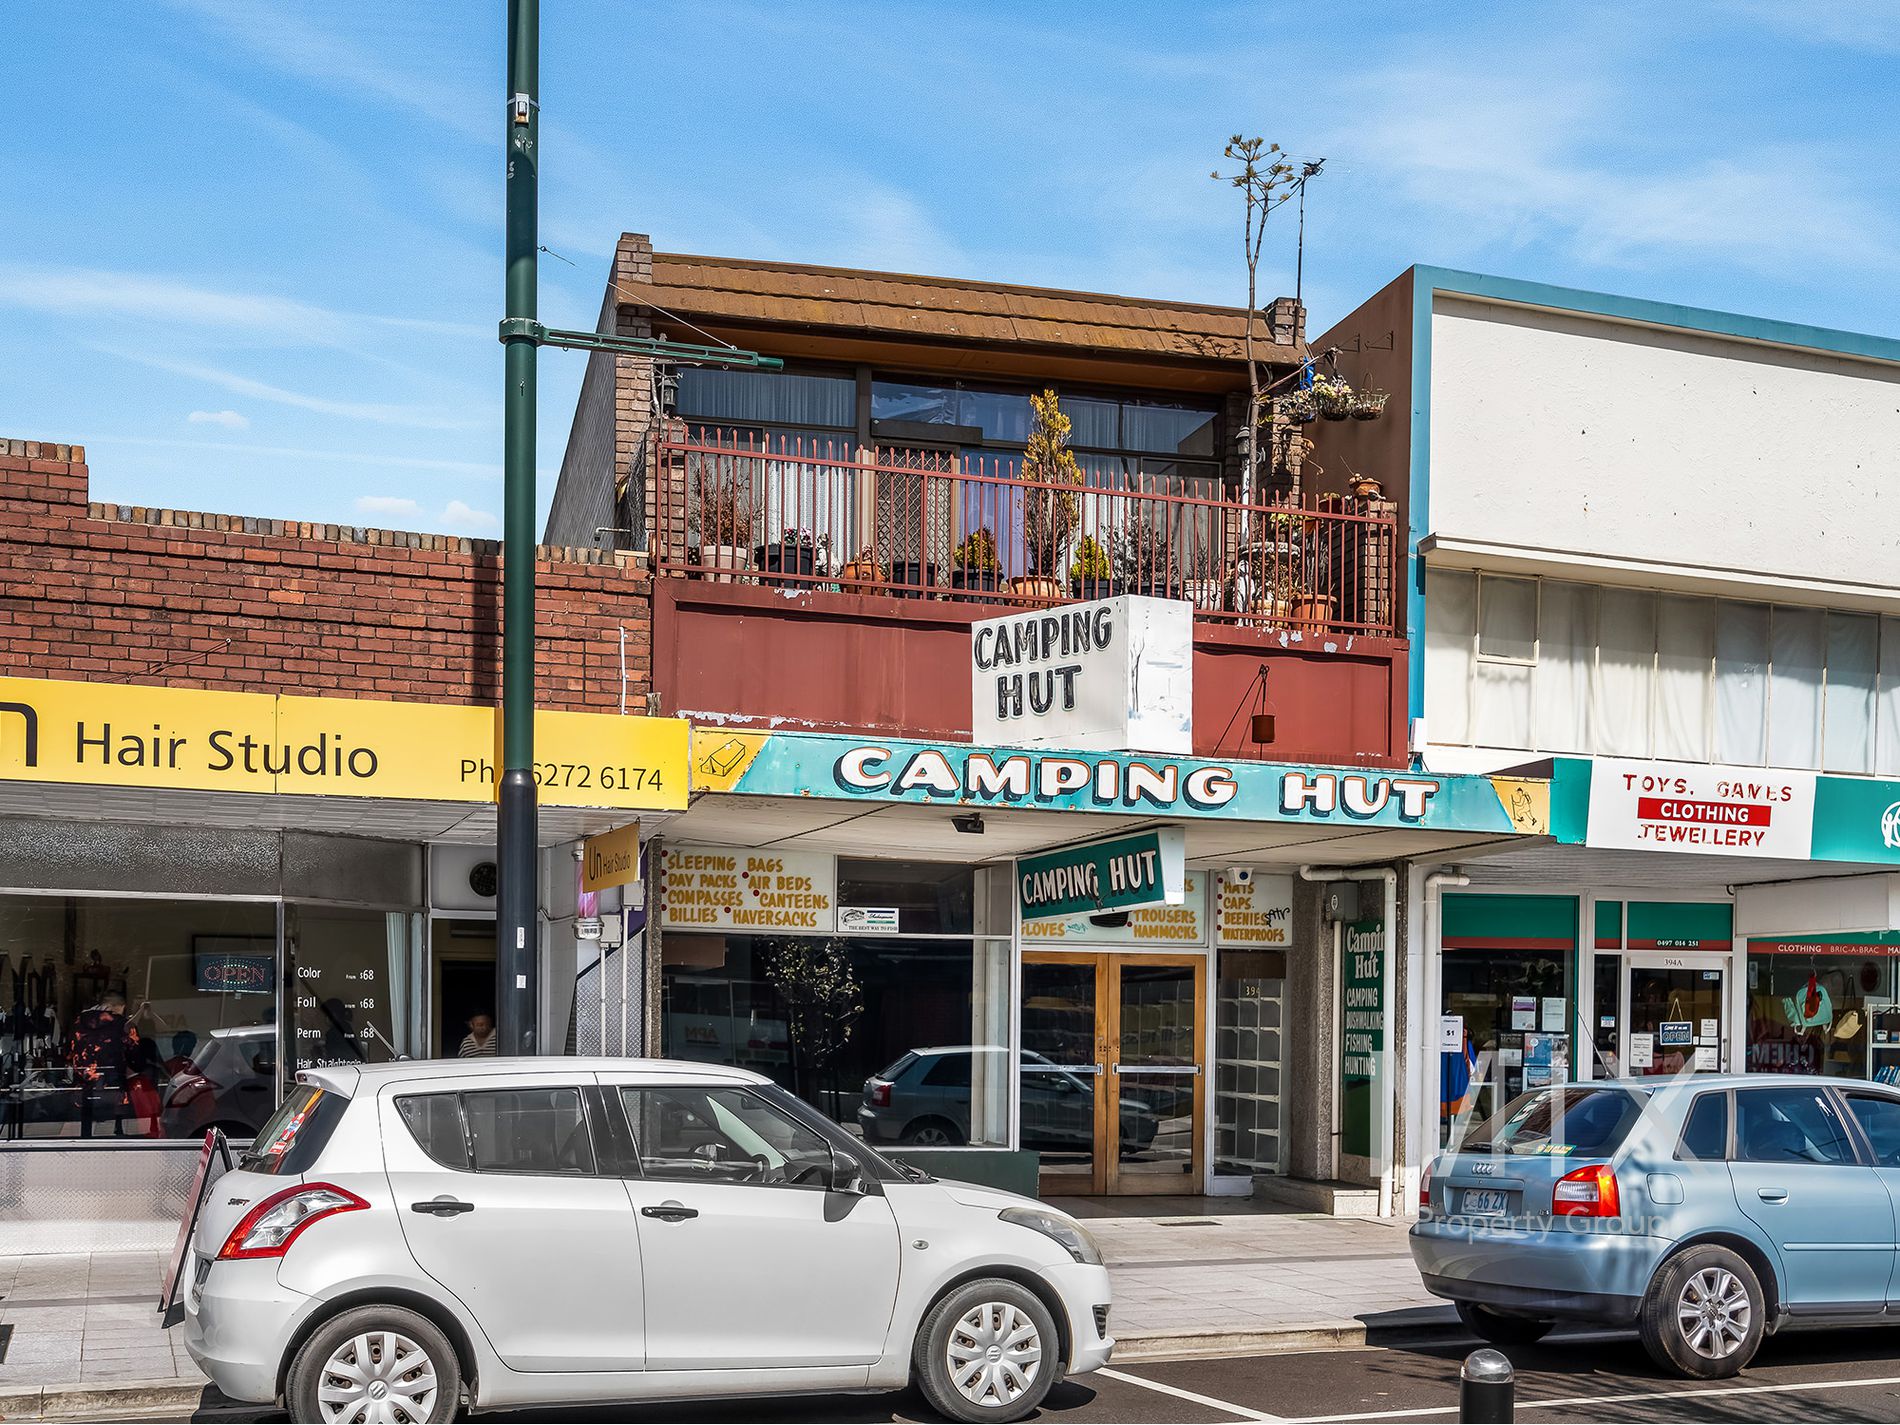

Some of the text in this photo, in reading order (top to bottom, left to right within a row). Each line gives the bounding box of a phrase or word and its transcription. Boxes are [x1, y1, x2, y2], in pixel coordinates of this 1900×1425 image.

[974, 606, 1112, 670] CAMPING
[996, 664, 1082, 721] HUT
[76, 721, 187, 768] Hair
[208, 730, 378, 778] Studio
[600, 766, 663, 791] 6174
[833, 746, 1440, 824] CAMPING HUT
[1660, 802, 1750, 823] CLOTHING
[1637, 824, 1766, 848] JEWELLERY
[589, 846, 603, 880] Un
[667, 854, 784, 873] SLEEPING BAGS
[668, 872, 813, 891] DAY PACKS AIR BEDS
[1022, 849, 1156, 905] CAMPING HUT
[1223, 880, 1255, 894] HATS
[668, 889, 830, 910] COMPASSES CANTEENS
[669, 906, 818, 928] BILLIES HAVERSACKS
[1133, 909, 1197, 923] TROUSERS
[1224, 912, 1268, 926] BEENIES
[1133, 925, 1198, 939] HAMMOCKS
[1222, 927, 1285, 942] WATERPROOFS
[1777, 944, 1822, 953] CLOTHING
[1355, 955, 1379, 979] Hut
[1664, 958, 1683, 966] 394A
[204, 966, 266, 983] OPEN
[297, 966, 321, 978] Color
[359, 969, 375, 980] $68
[297, 996, 317, 1008] Foil
[359, 998, 375, 1009] $68
[1346, 987, 1378, 1007] CAMPING
[296, 1027, 321, 1039] Perm
[359, 1027, 375, 1039] $68
[1662, 1031, 1690, 1042] OPEN
[1346, 1033, 1373, 1053] FISHING
[296, 1058, 313, 1069] Hair
[1344, 1055, 1376, 1077] HUNTING
[1477, 1191, 1490, 1210] 66
